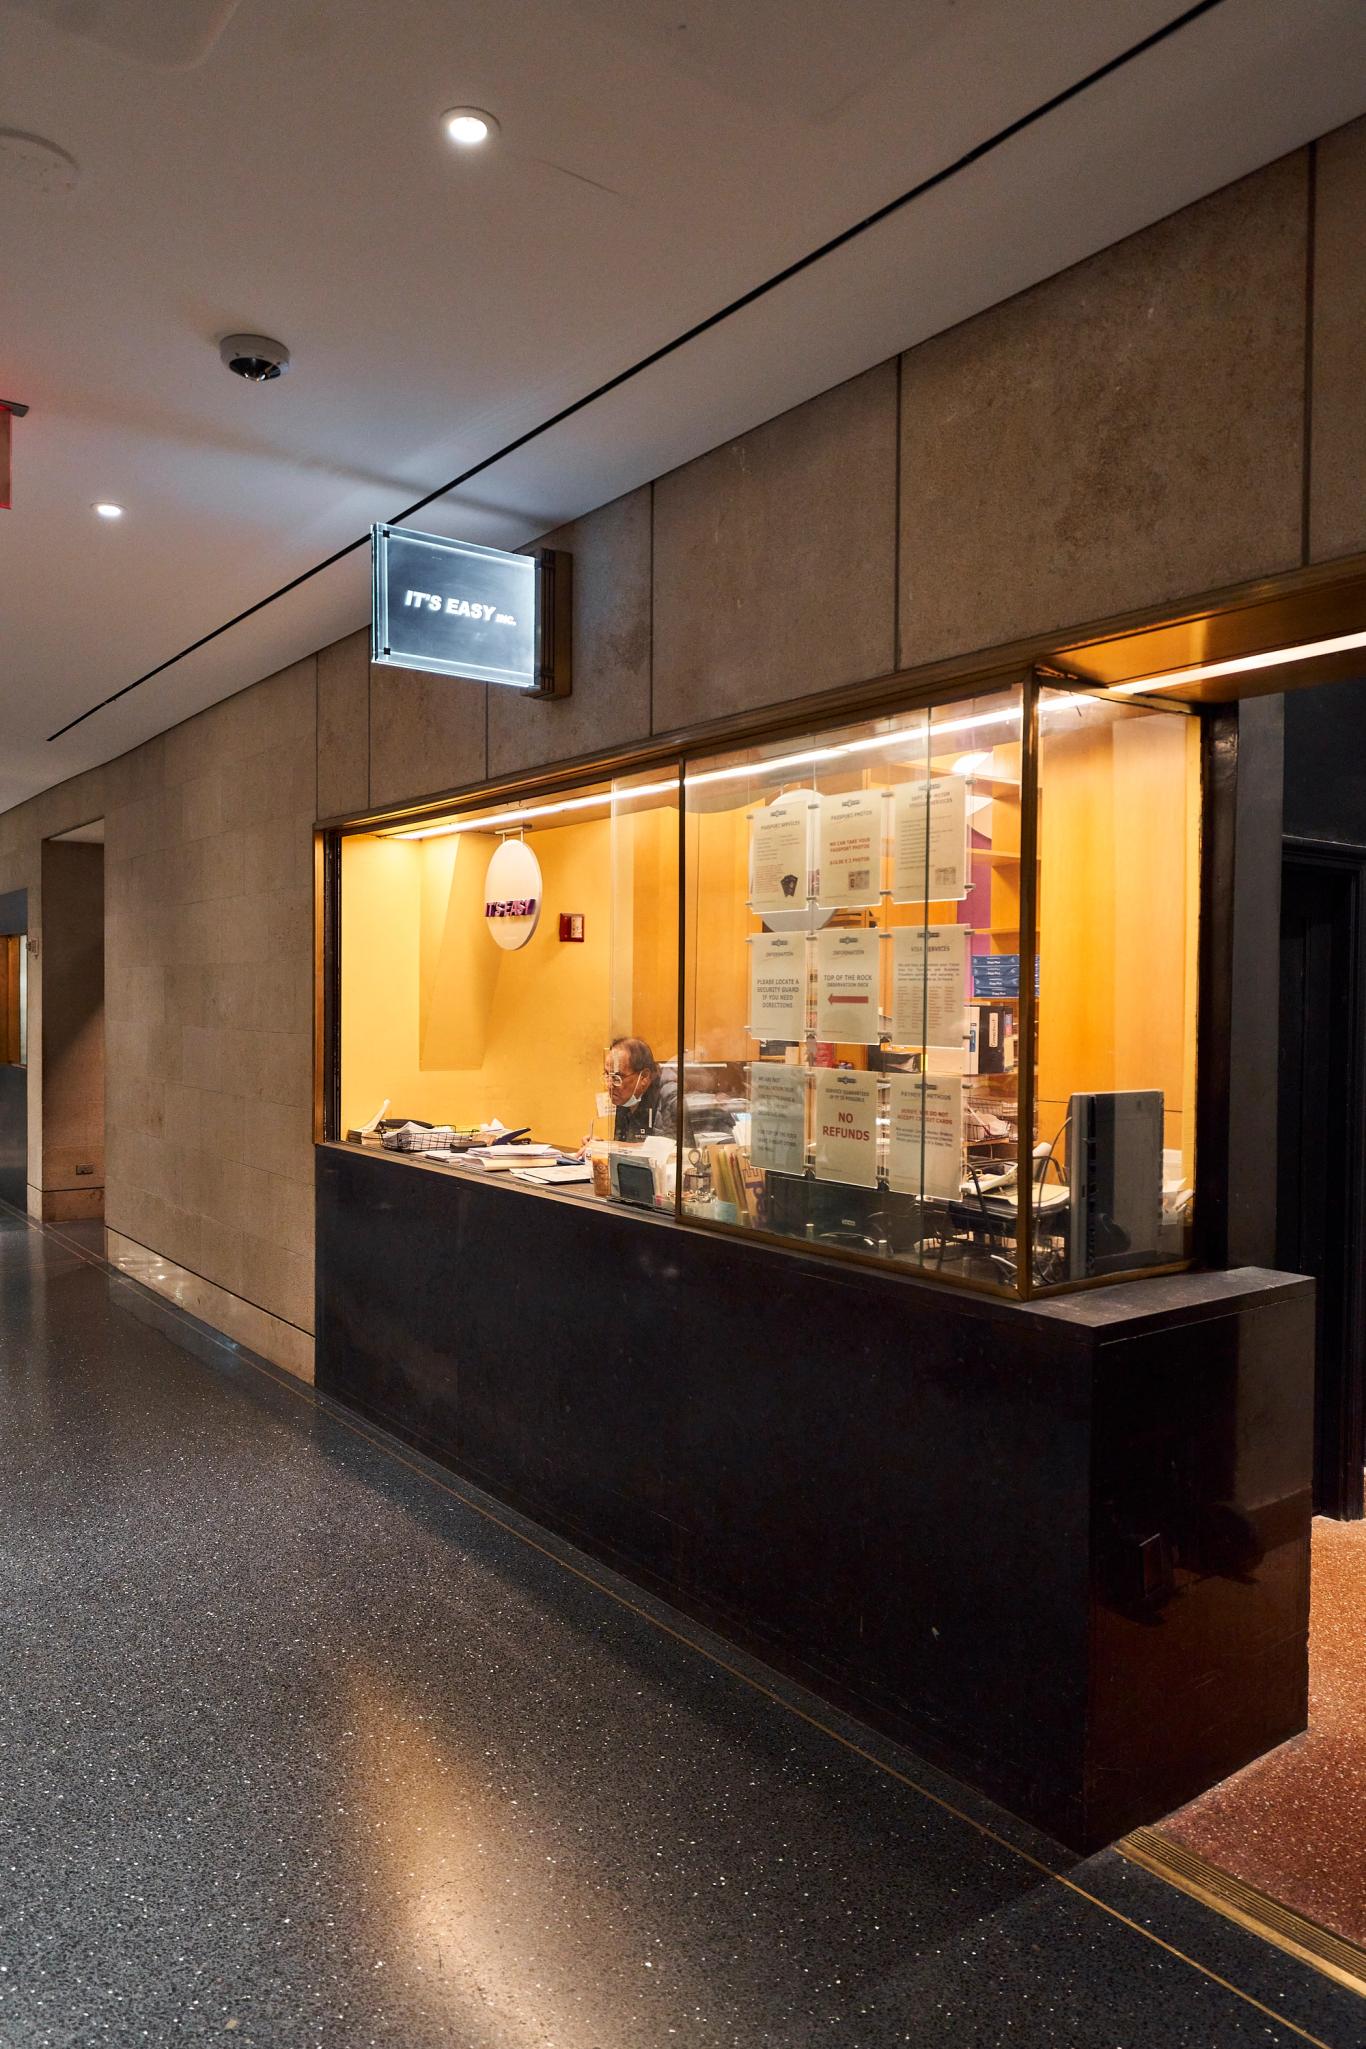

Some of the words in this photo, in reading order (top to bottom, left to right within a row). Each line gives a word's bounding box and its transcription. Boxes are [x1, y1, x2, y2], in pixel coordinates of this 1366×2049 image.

[405, 590, 442, 611] IT'S
[446, 598, 497, 621] EASY
[495, 613, 517, 626] INC.
[838, 1112, 853, 1123] NO
[822, 1125, 870, 1141] REFUNDS
